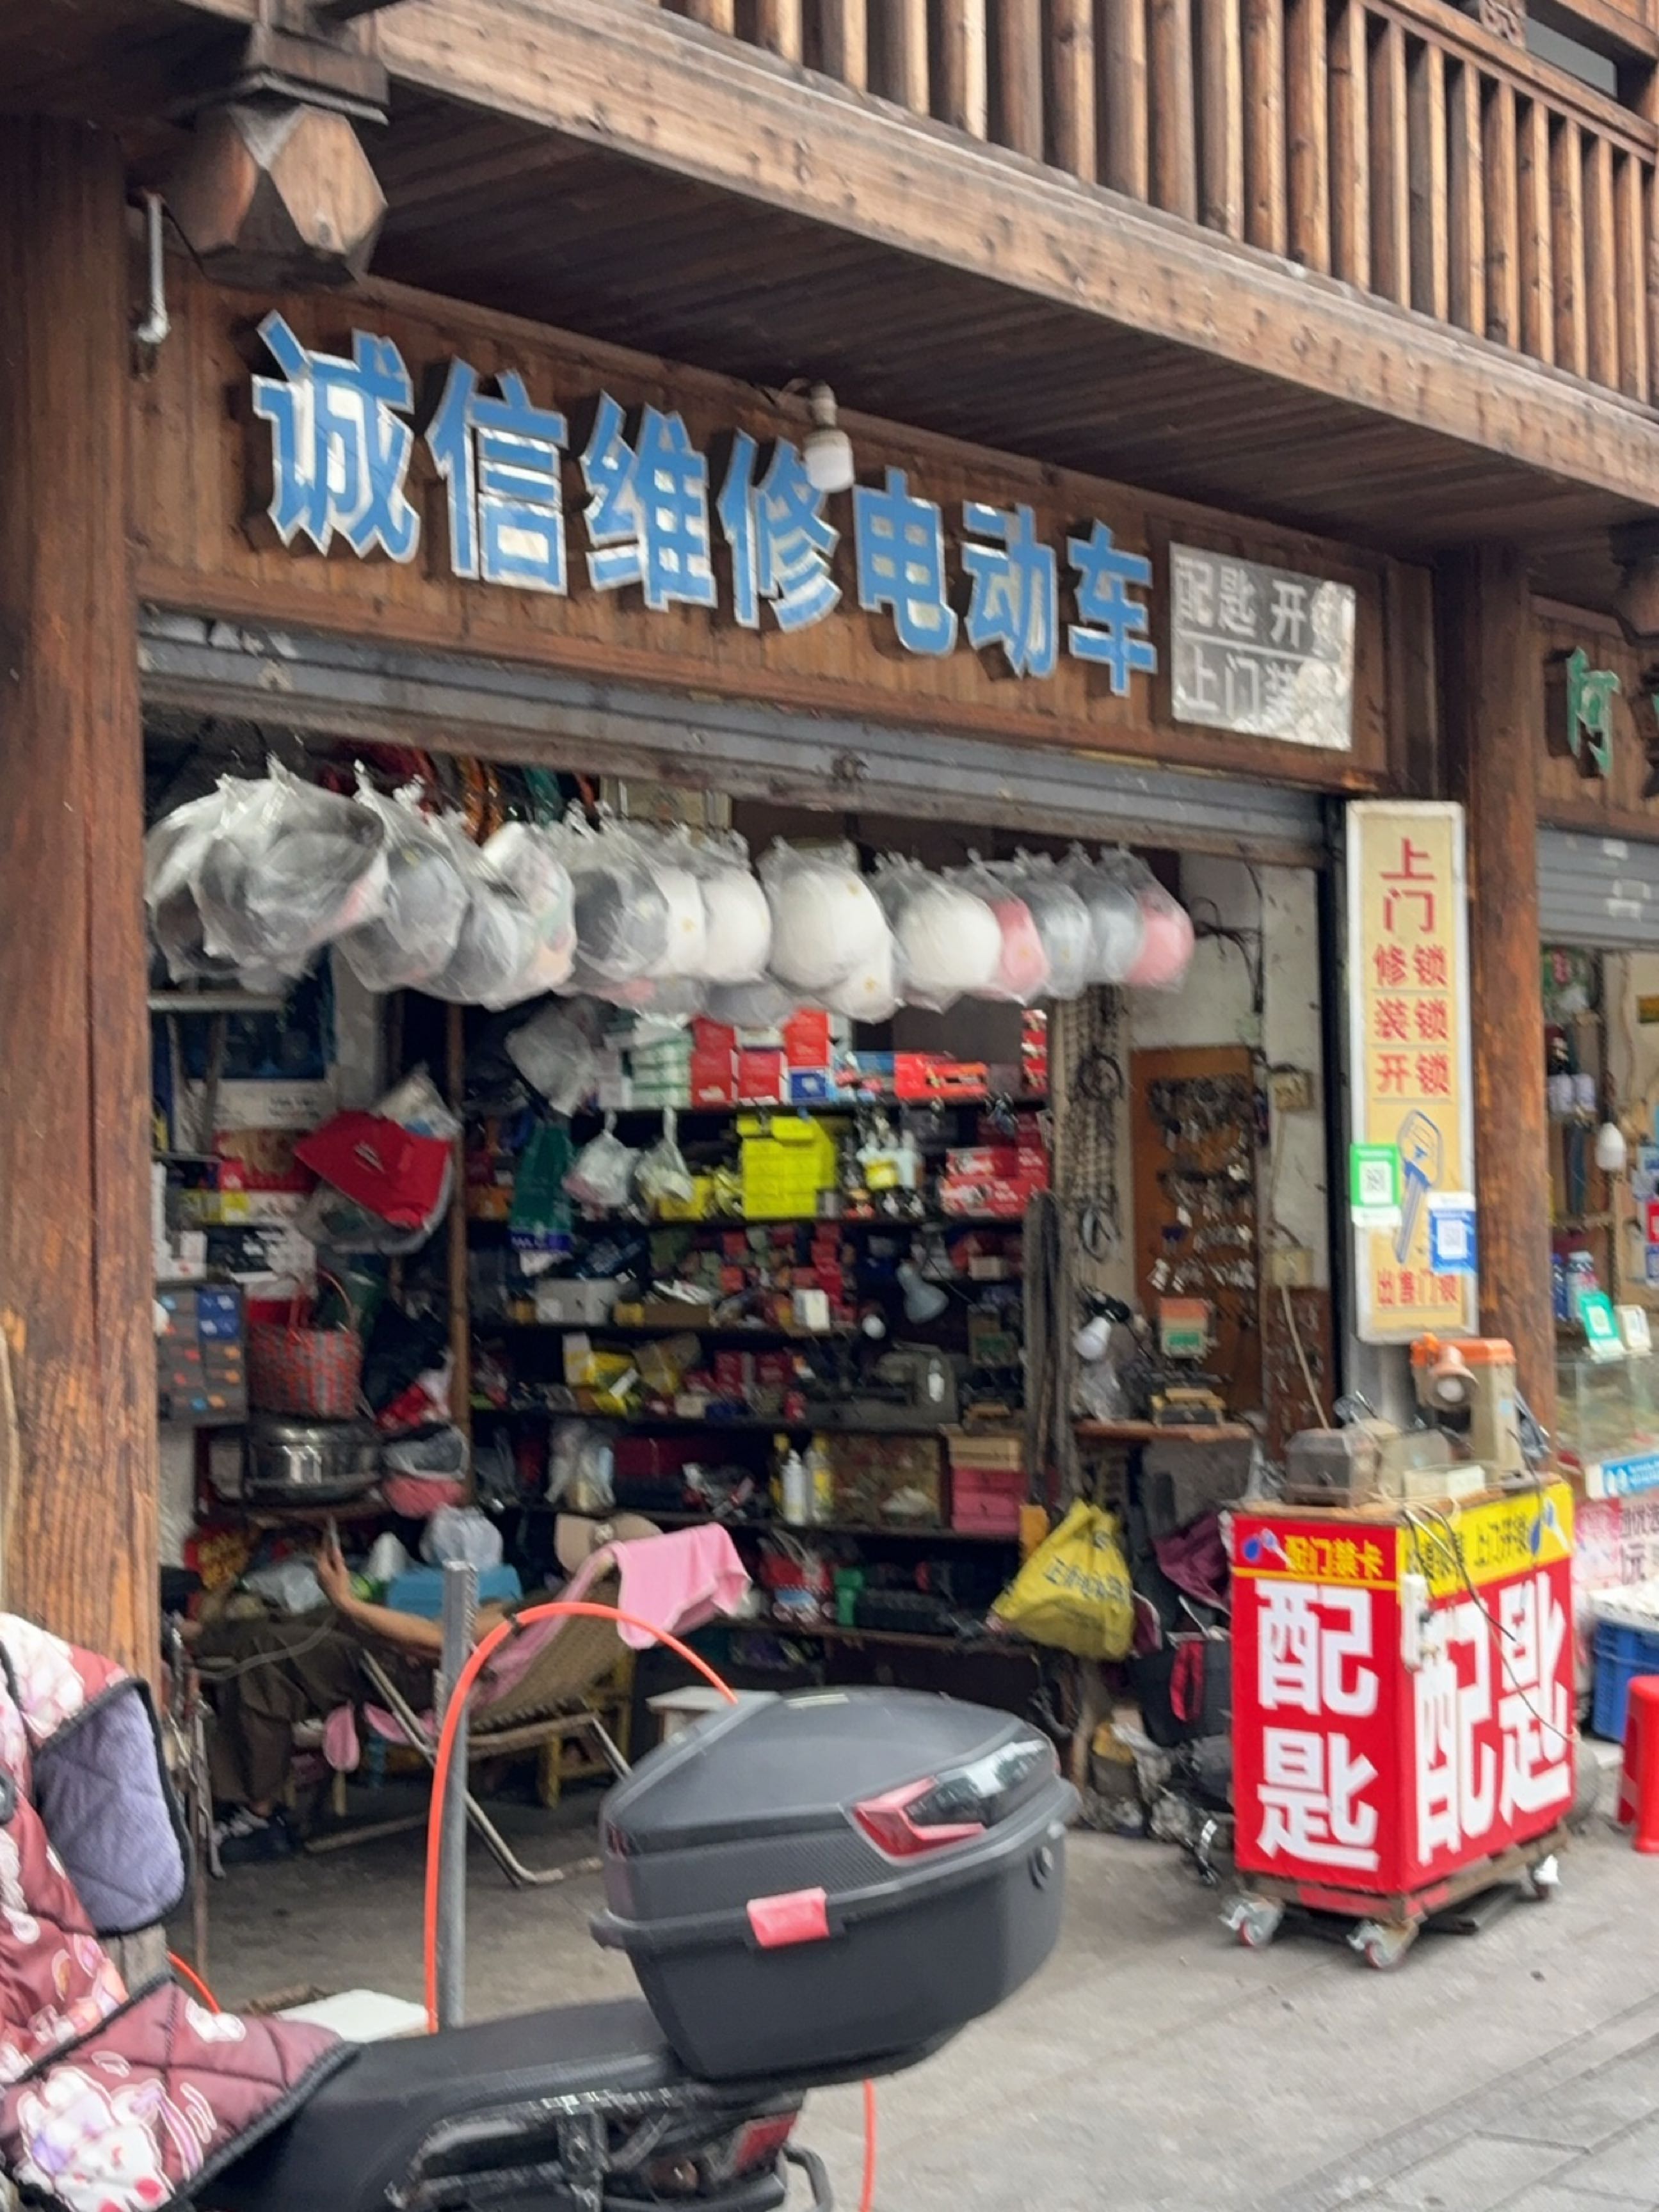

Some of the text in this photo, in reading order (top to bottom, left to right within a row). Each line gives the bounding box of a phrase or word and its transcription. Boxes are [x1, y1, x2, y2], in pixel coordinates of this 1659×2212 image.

[251, 308, 1158, 698] 诚信维修电动车
[1184, 644, 1331, 727] 上门装
[1380, 835, 1438, 934] 上门
[1372, 943, 1449, 988] 修锁
[1373, 997, 1450, 1042] 装锁
[1375, 1051, 1451, 1096] 开锁
[1253, 1578, 1380, 1872] 配匙
[1413, 1571, 1572, 1866] 配匙
